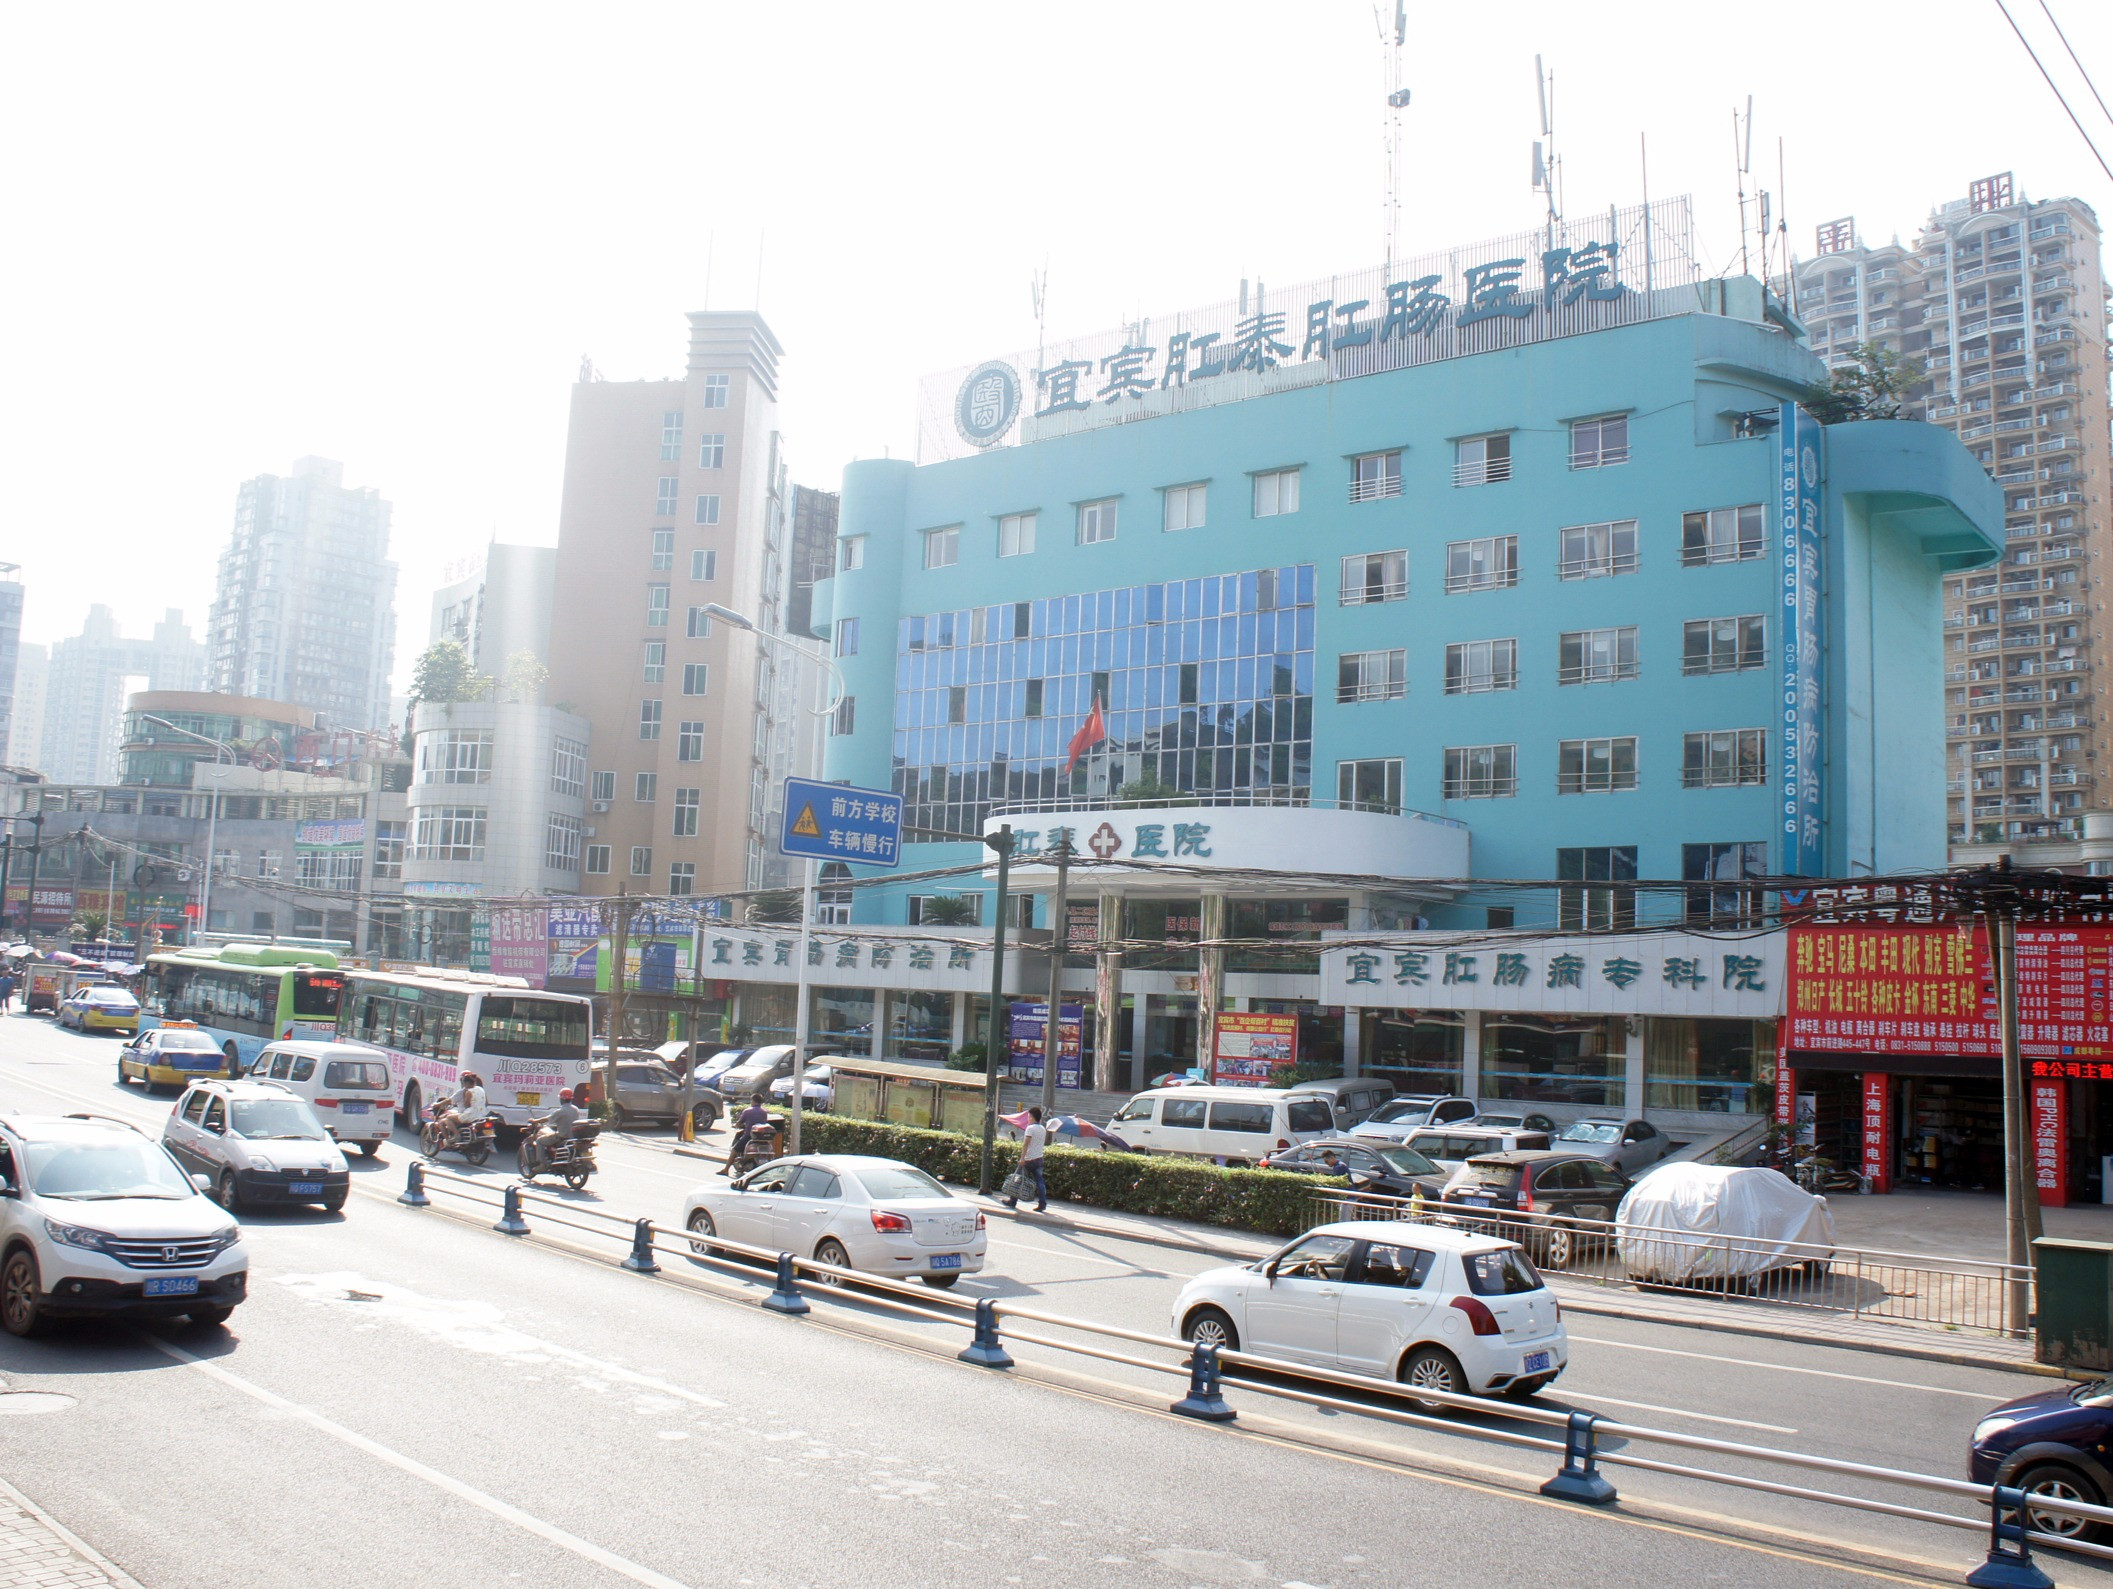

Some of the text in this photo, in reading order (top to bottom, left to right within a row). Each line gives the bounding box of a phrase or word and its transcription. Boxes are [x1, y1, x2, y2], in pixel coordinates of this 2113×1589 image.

[1036, 241, 1624, 417] 宜宾肛泰肛肠医院
[832, 797, 896, 824] 前方学校
[828, 829, 893, 855] 车辆慢行
[1131, 822, 1212, 858] 医院
[555, 924, 598, 936] 滤清器专卖
[1345, 952, 1766, 991] 宜宾肛肠病专科院
[1797, 933, 1814, 974] 奔驰
[1818, 933, 1834, 974] 宝马
[1838, 934, 1855, 974] 尼桑
[1860, 933, 1876, 975] 本田
[1881, 933, 1898, 975] 丰田
[1902, 934, 1920, 975] 现代
[1924, 933, 1942, 975] 别克
[1797, 979, 1825, 1012] 郑州日产
[1829, 979, 1843, 1013] 长城
[1847, 980, 1868, 1013] 五十铃
[1904, 980, 1919, 1015] 金杯
[1923, 981, 1938, 1015] 东南
[1942, 981, 1957, 1016] 三菱
[1960, 981, 1976, 1017] 中华
[492, 1073, 566, 1087] 宜宾玛莉亚医院
[497, 1059, 562, 1074] 川Q28573
[2032, 1061, 2113, 1079] 我公司主营
[1865, 1083, 1881, 1177] 上海顶耐电瓶
[2036, 1088, 2058, 1189] 韩国PHC法雷奥离合器
